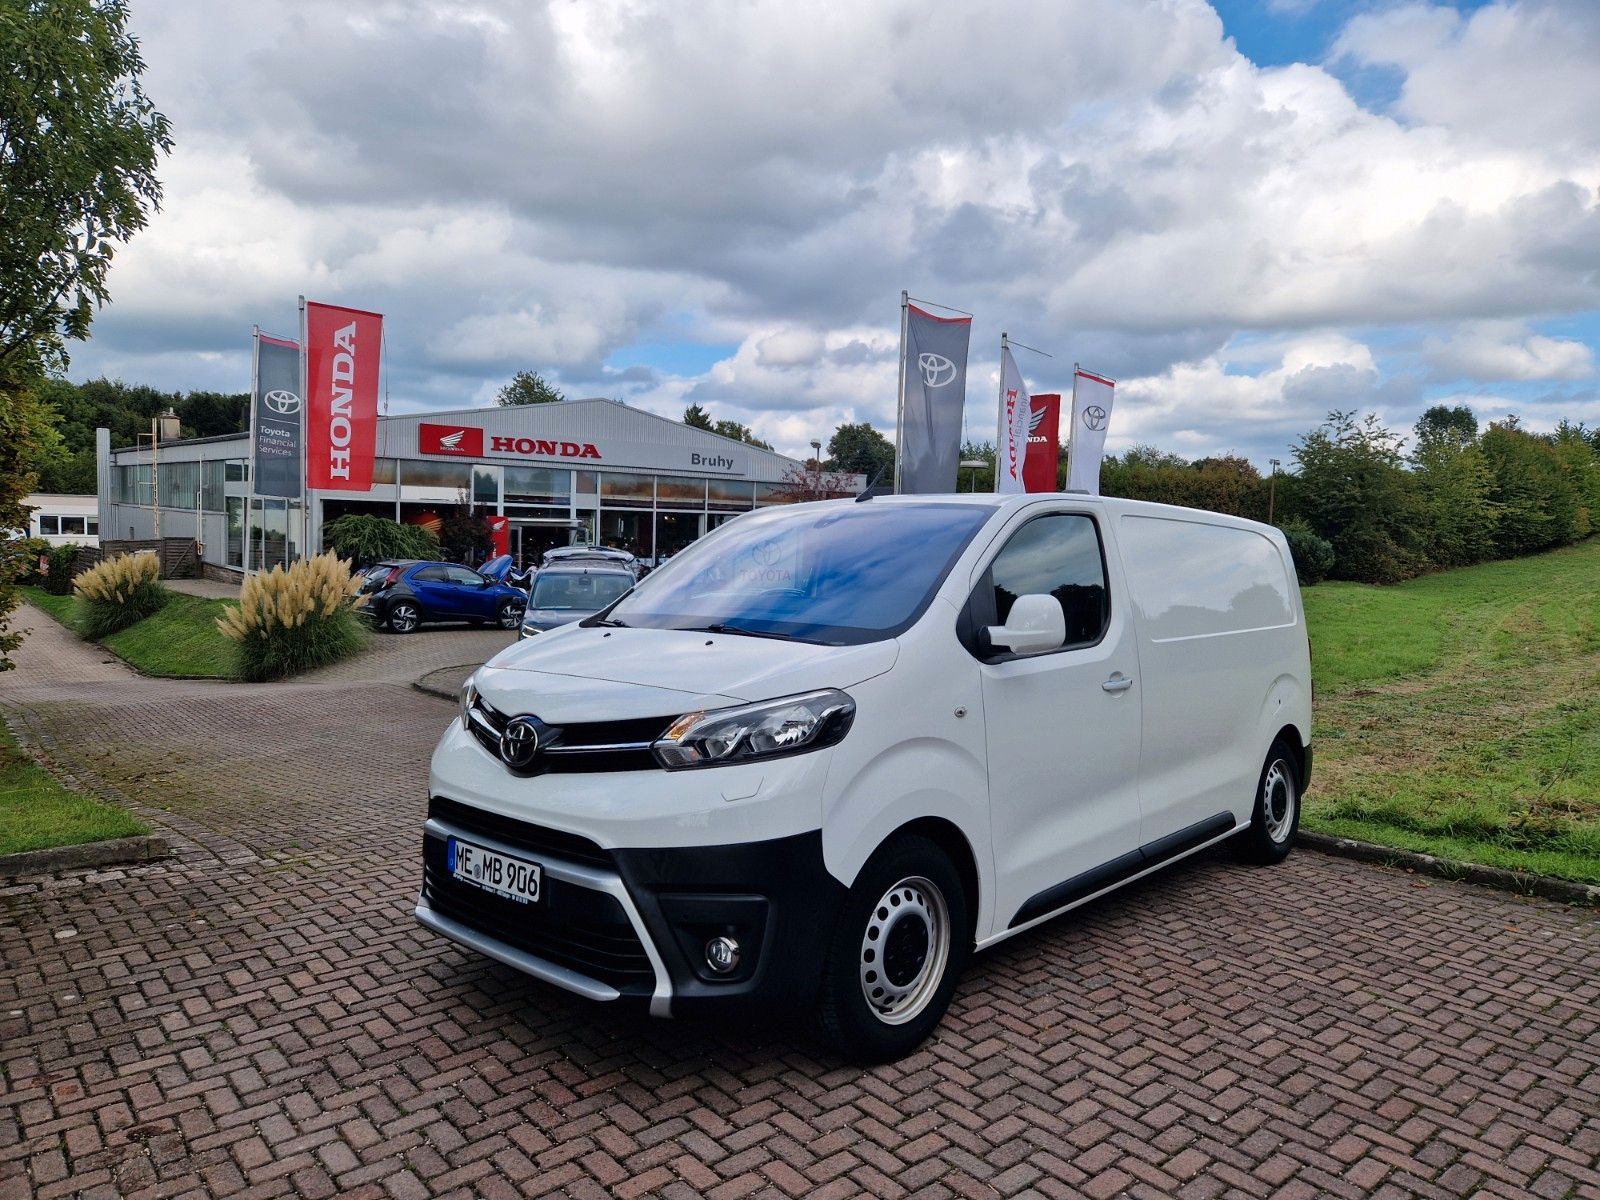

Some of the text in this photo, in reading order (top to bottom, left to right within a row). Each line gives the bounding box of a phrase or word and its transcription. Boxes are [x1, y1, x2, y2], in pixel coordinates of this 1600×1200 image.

[329, 320, 357, 481] HONDA
[260, 425, 290, 438] Toyota
[259, 435, 296, 448] Financial
[1026, 435, 1048, 443] NDA
[258, 444, 292, 456] Services
[491, 436, 602, 459] HONDA
[691, 453, 734, 470] Bruhy
[739, 568, 791, 582] TOYOTA
[455, 844, 473, 875] ME
[482, 853, 503, 885] MB
[506, 862, 538, 897] 906
